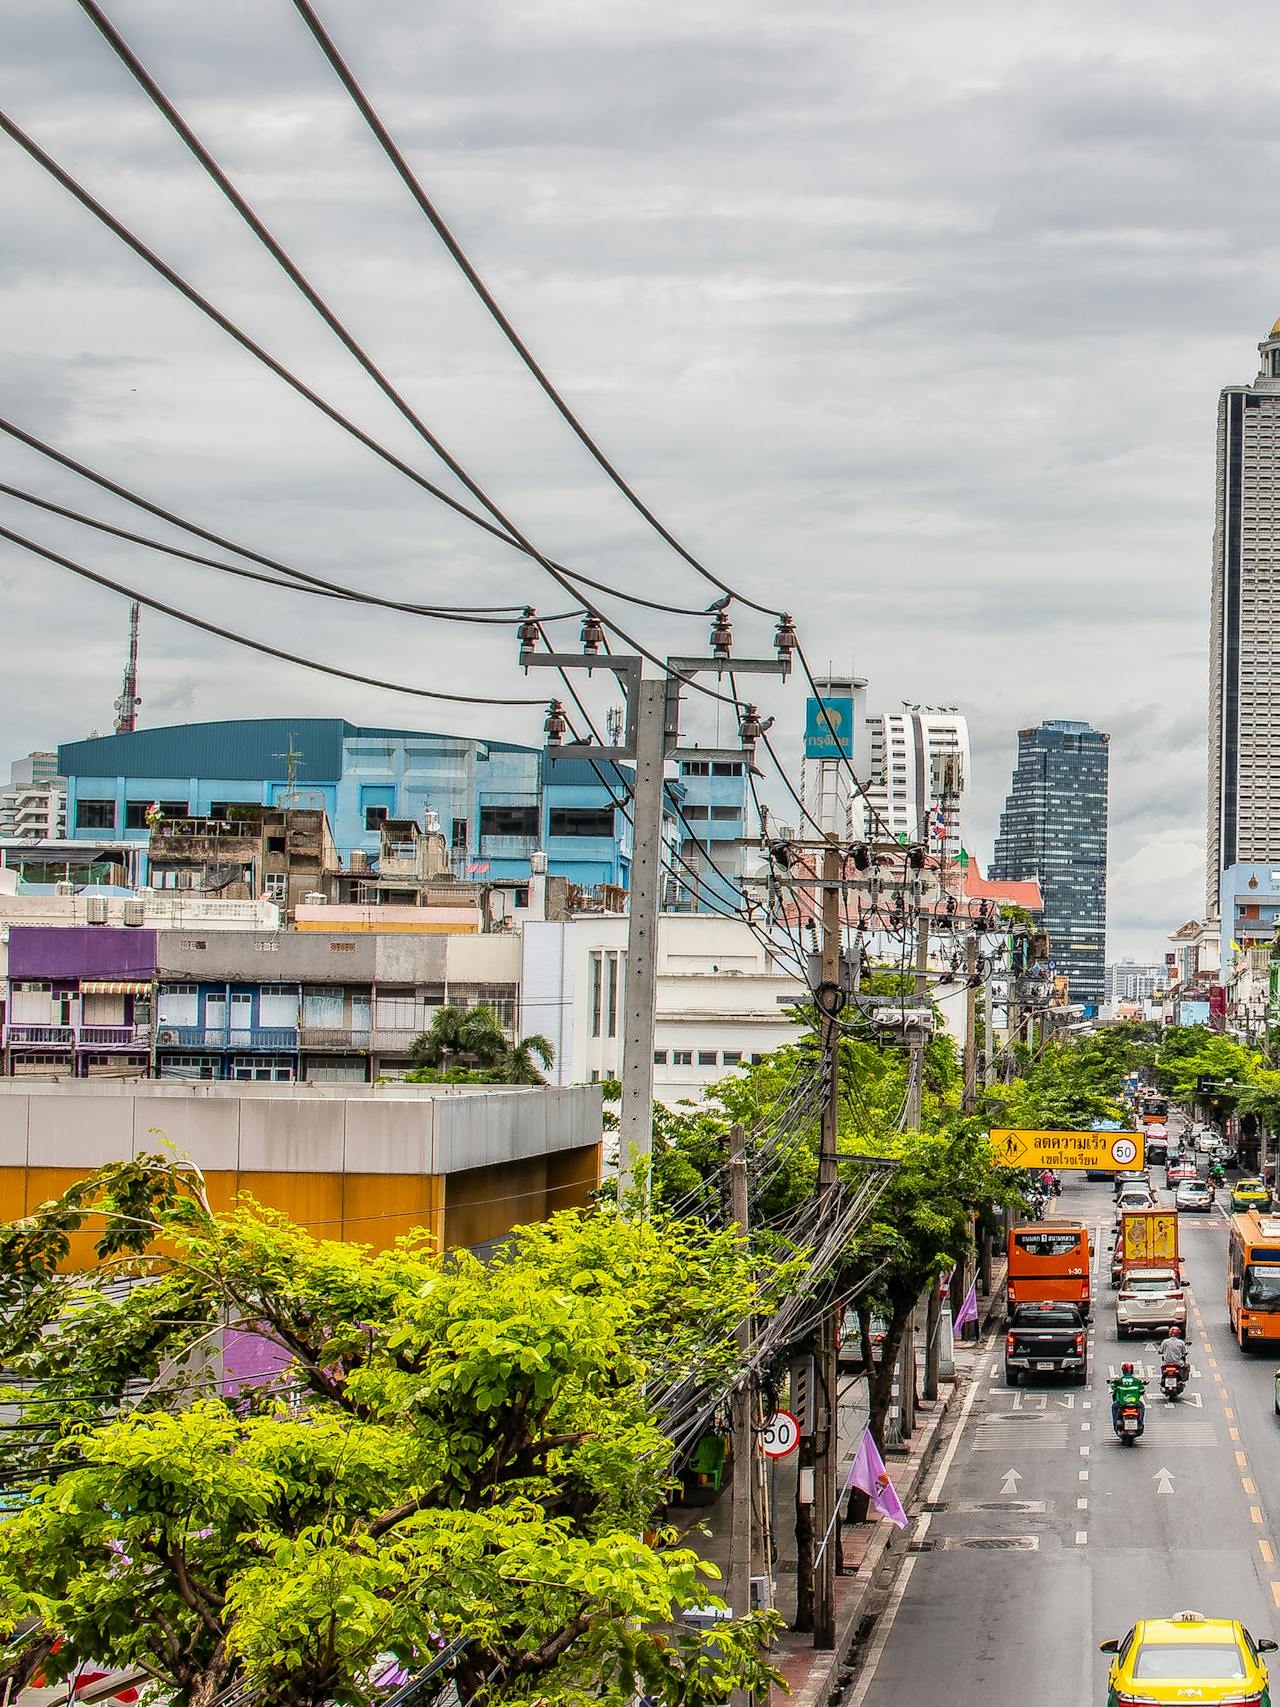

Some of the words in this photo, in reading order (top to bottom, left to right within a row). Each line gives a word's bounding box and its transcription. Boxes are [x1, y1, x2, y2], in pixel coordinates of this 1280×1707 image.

[1034, 1133, 1107, 1150] ลดความเร็ว
[1041, 1151, 1098, 1166] เขตโรงเรียน
[1116, 1146, 1132, 1158] 50
[763, 1424, 790, 1444] 50
[1181, 1613, 1196, 1621] TAXI
